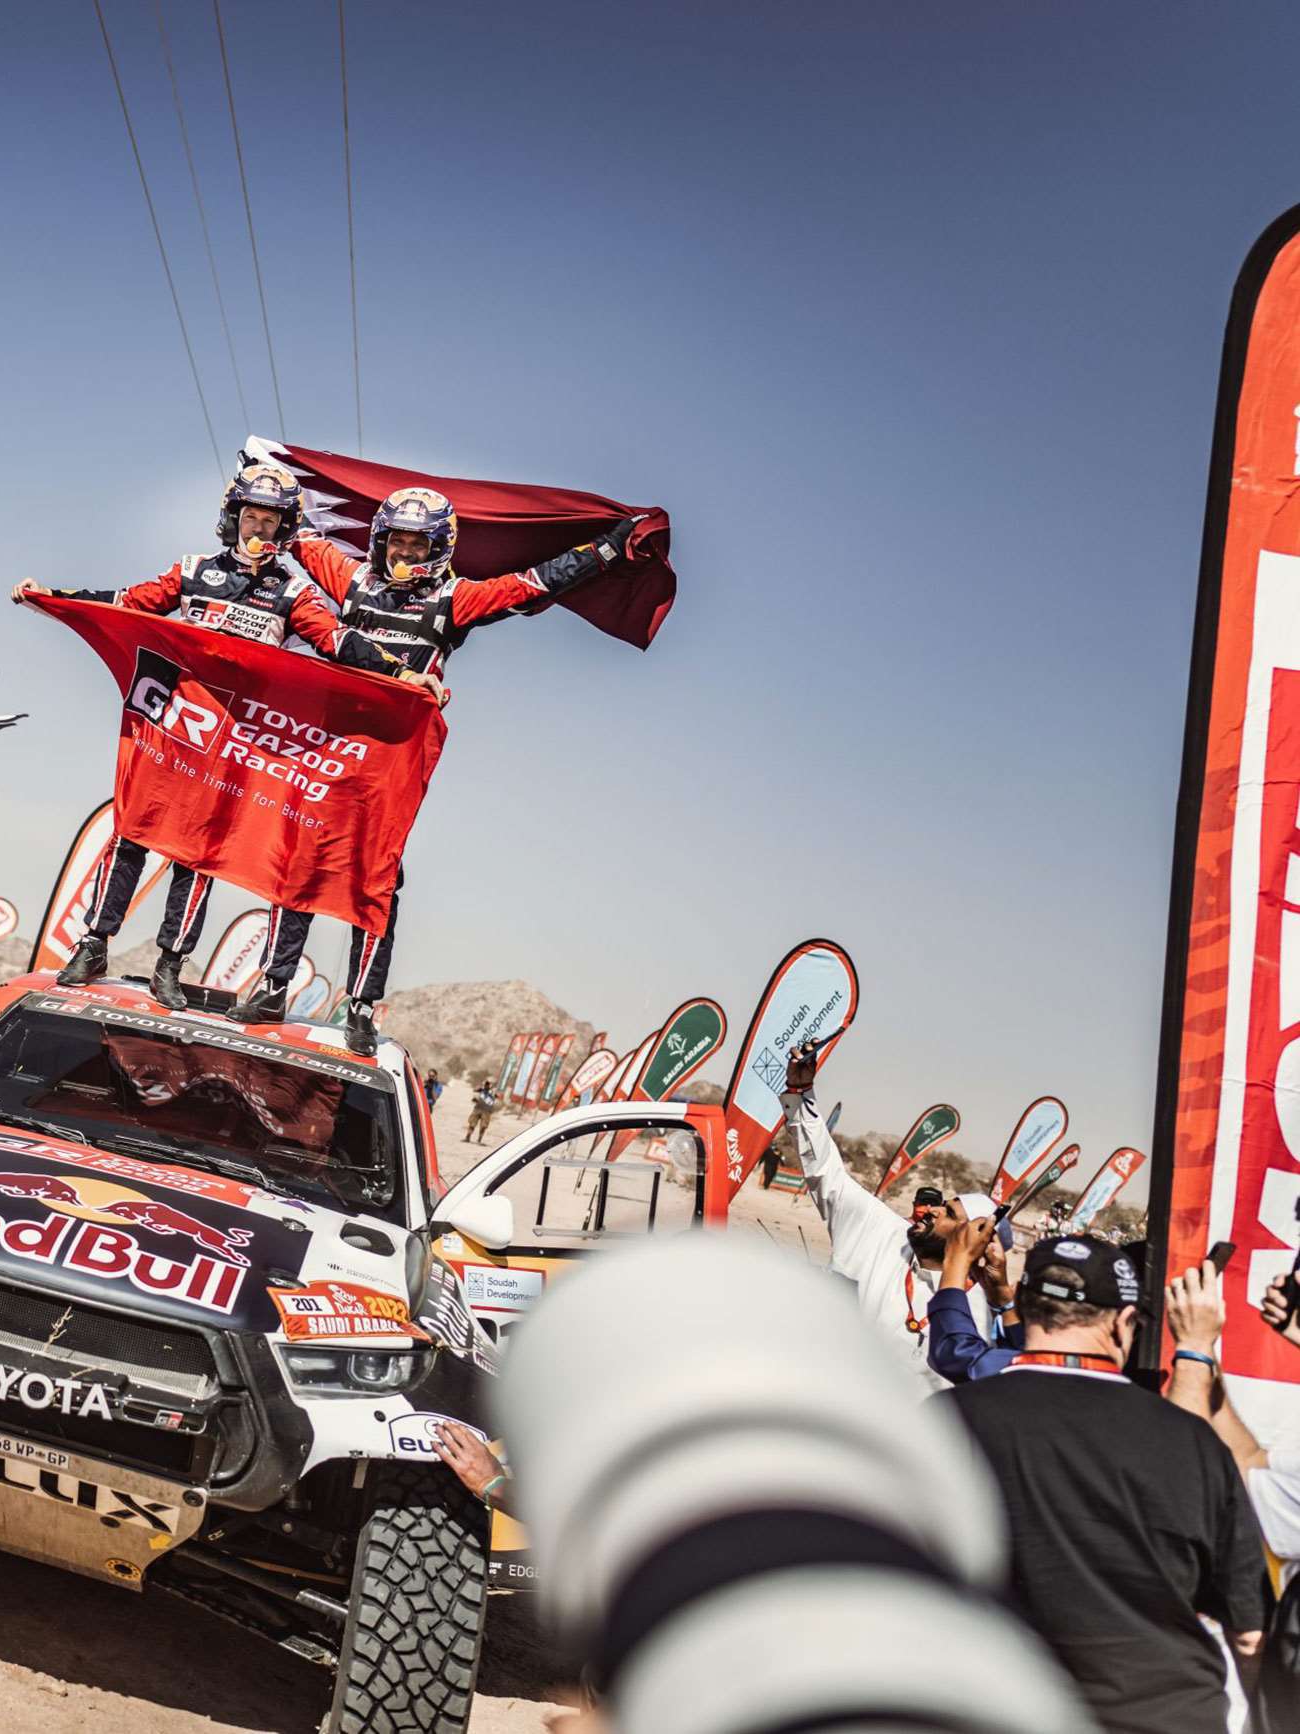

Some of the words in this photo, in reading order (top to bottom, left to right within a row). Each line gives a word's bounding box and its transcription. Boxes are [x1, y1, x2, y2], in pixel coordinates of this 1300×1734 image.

[189, 606, 222, 625] GR
[226, 613, 267, 630] GAZOO
[231, 606, 273, 624] TOYOTA
[220, 619, 263, 637] Racing
[131, 676, 218, 748] GR
[242, 698, 369, 761] TOYOTA
[230, 721, 345, 778] GAZOO
[220, 740, 330, 803] Racing
[173, 757, 197, 778] the
[202, 772, 245, 798] limits
[252, 791, 276, 809] for
[282, 803, 325, 830] Better
[51, 986, 113, 1003] MOTUL
[774, 1002, 811, 1051] Soudah
[40, 1000, 82, 1014] GR
[91, 1007, 186, 1034] TOYOTA
[192, 1030, 283, 1058] GAZOO
[285, 1051, 373, 1084] Racing
[487, 1277, 518, 1288] Soudah
[292, 1298, 322, 1312] 201
[364, 1296, 408, 1324] 2022
[308, 1317, 352, 1334] SAUDI
[353, 1317, 405, 1333] ARABIA
